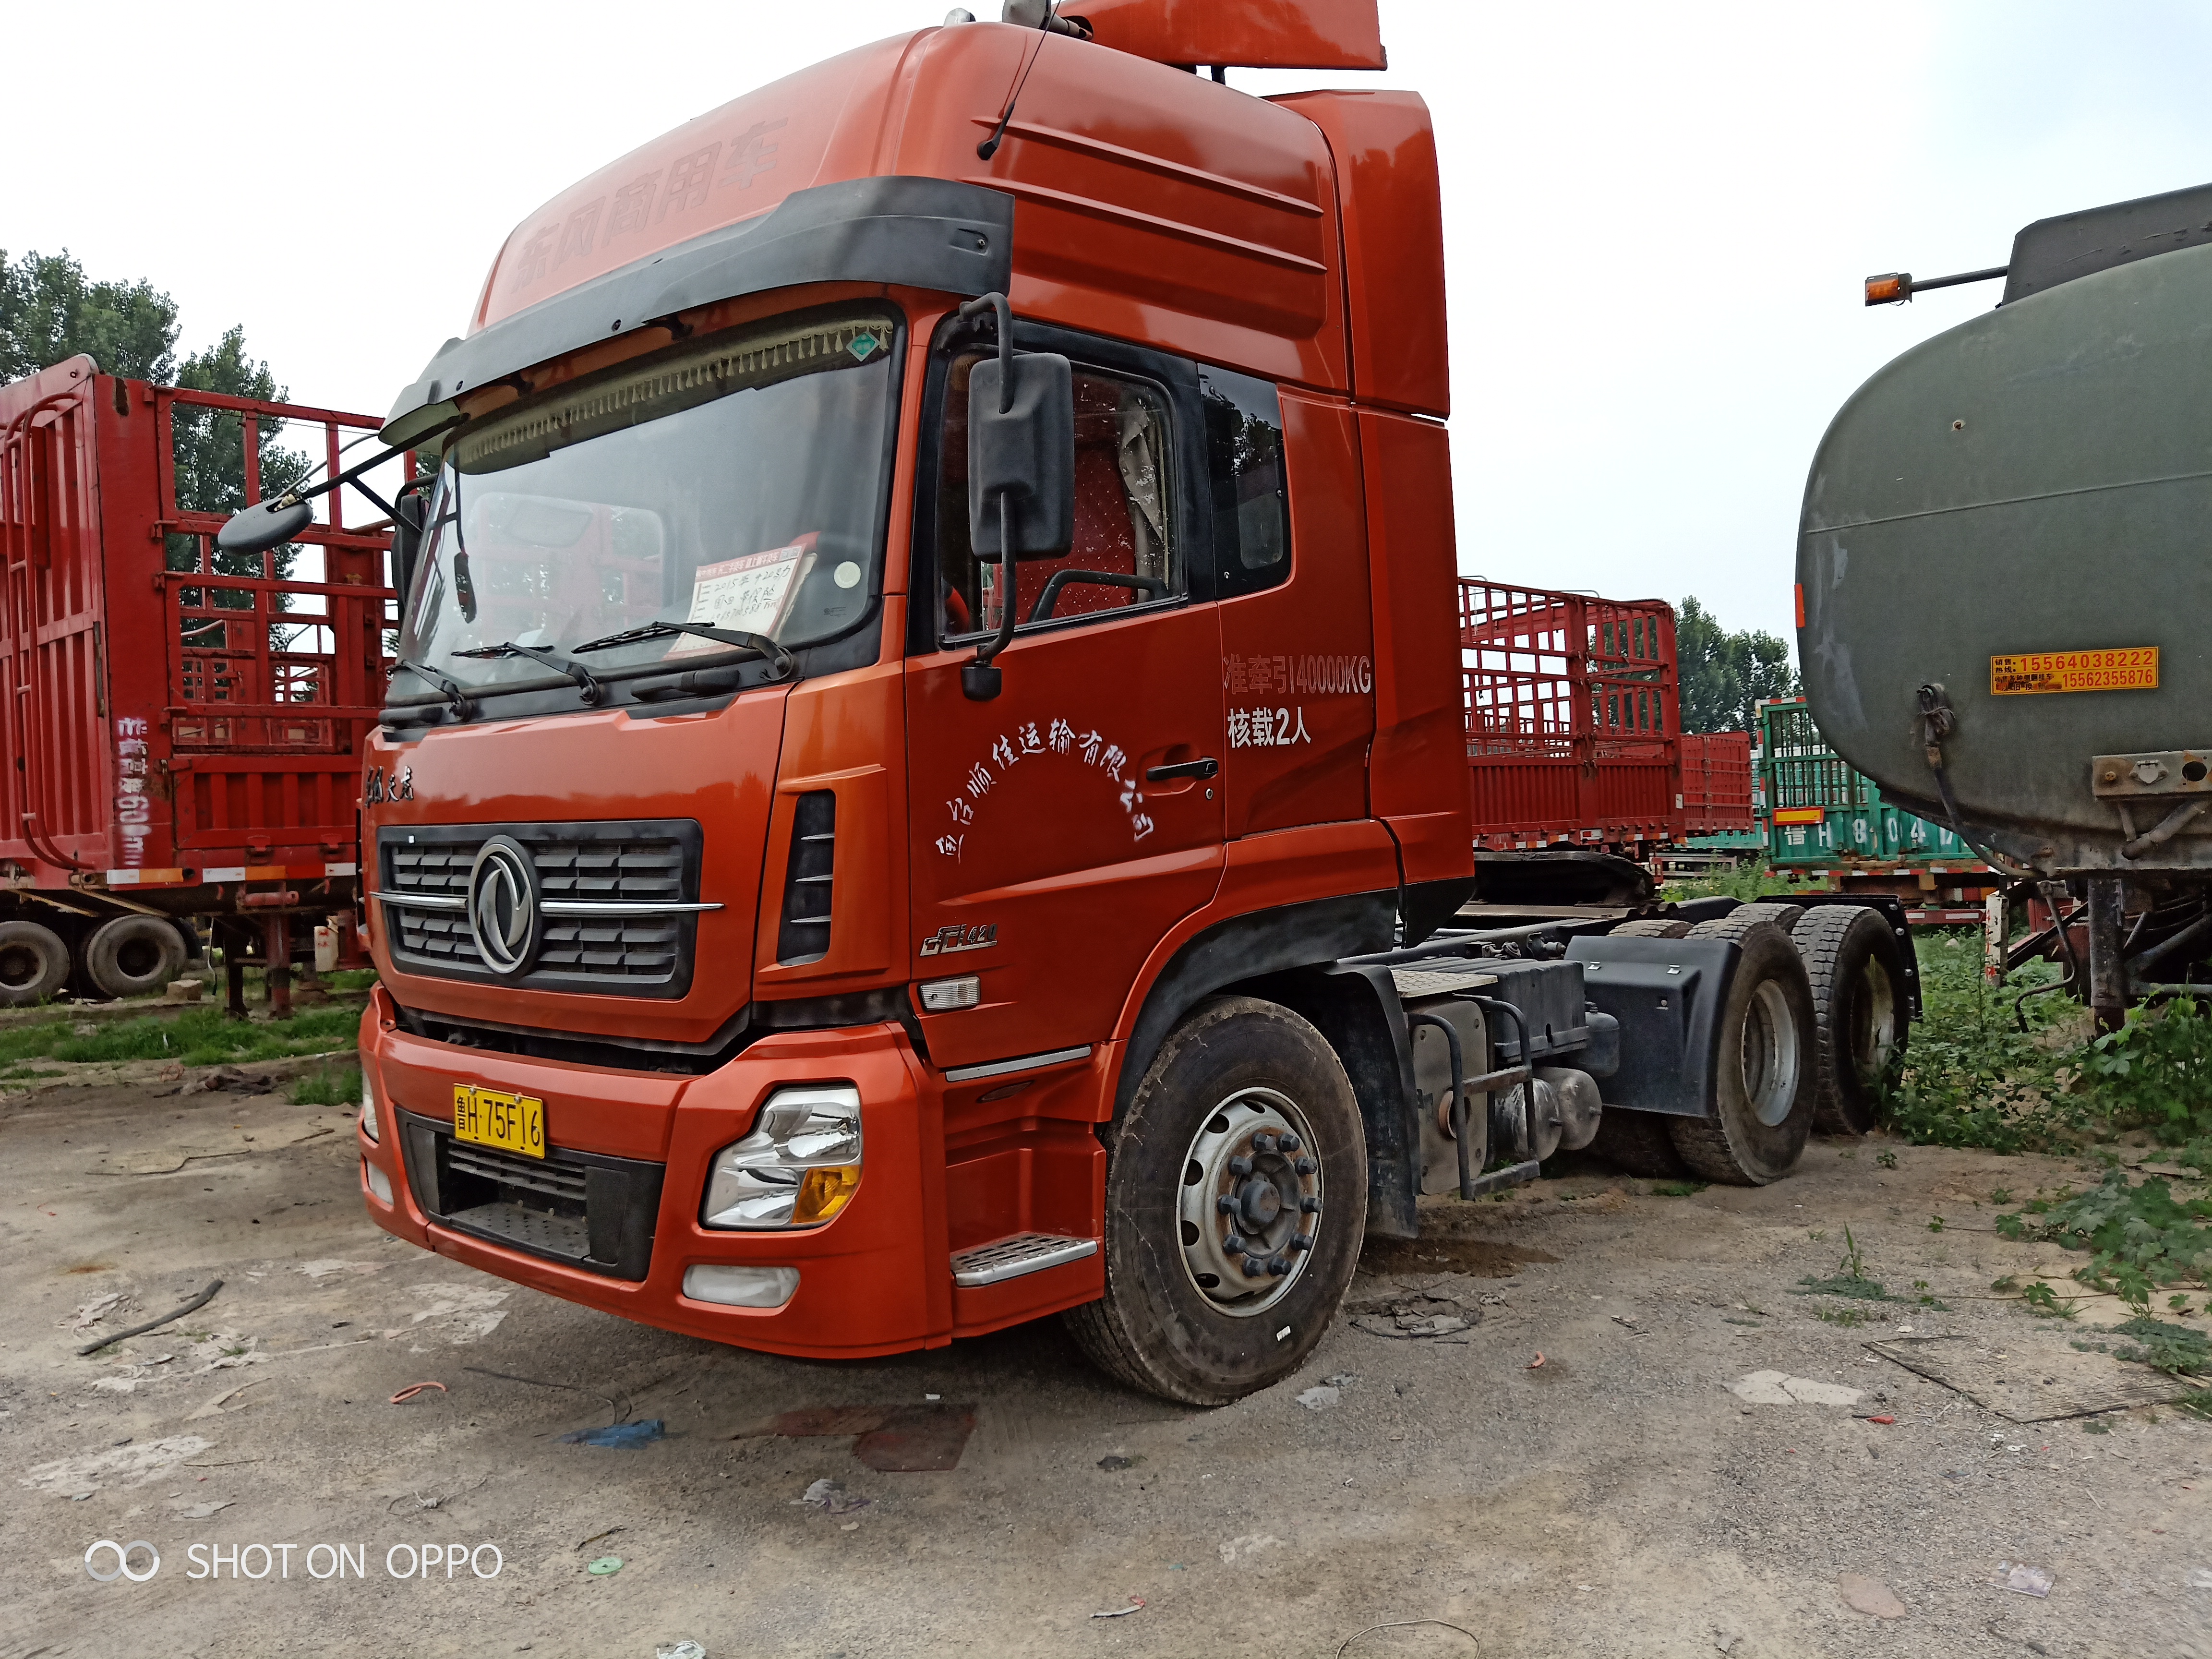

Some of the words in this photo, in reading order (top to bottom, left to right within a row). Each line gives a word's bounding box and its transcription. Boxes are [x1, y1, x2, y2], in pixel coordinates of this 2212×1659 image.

[510, 117, 788, 294] 东风商用车
[1223, 653, 1371, 695] 准牵引40000KG
[2020, 650, 2153, 672] 15564038222
[2062, 669, 2153, 688] 15562355876
[1227, 707, 1311, 748] 核载2人
